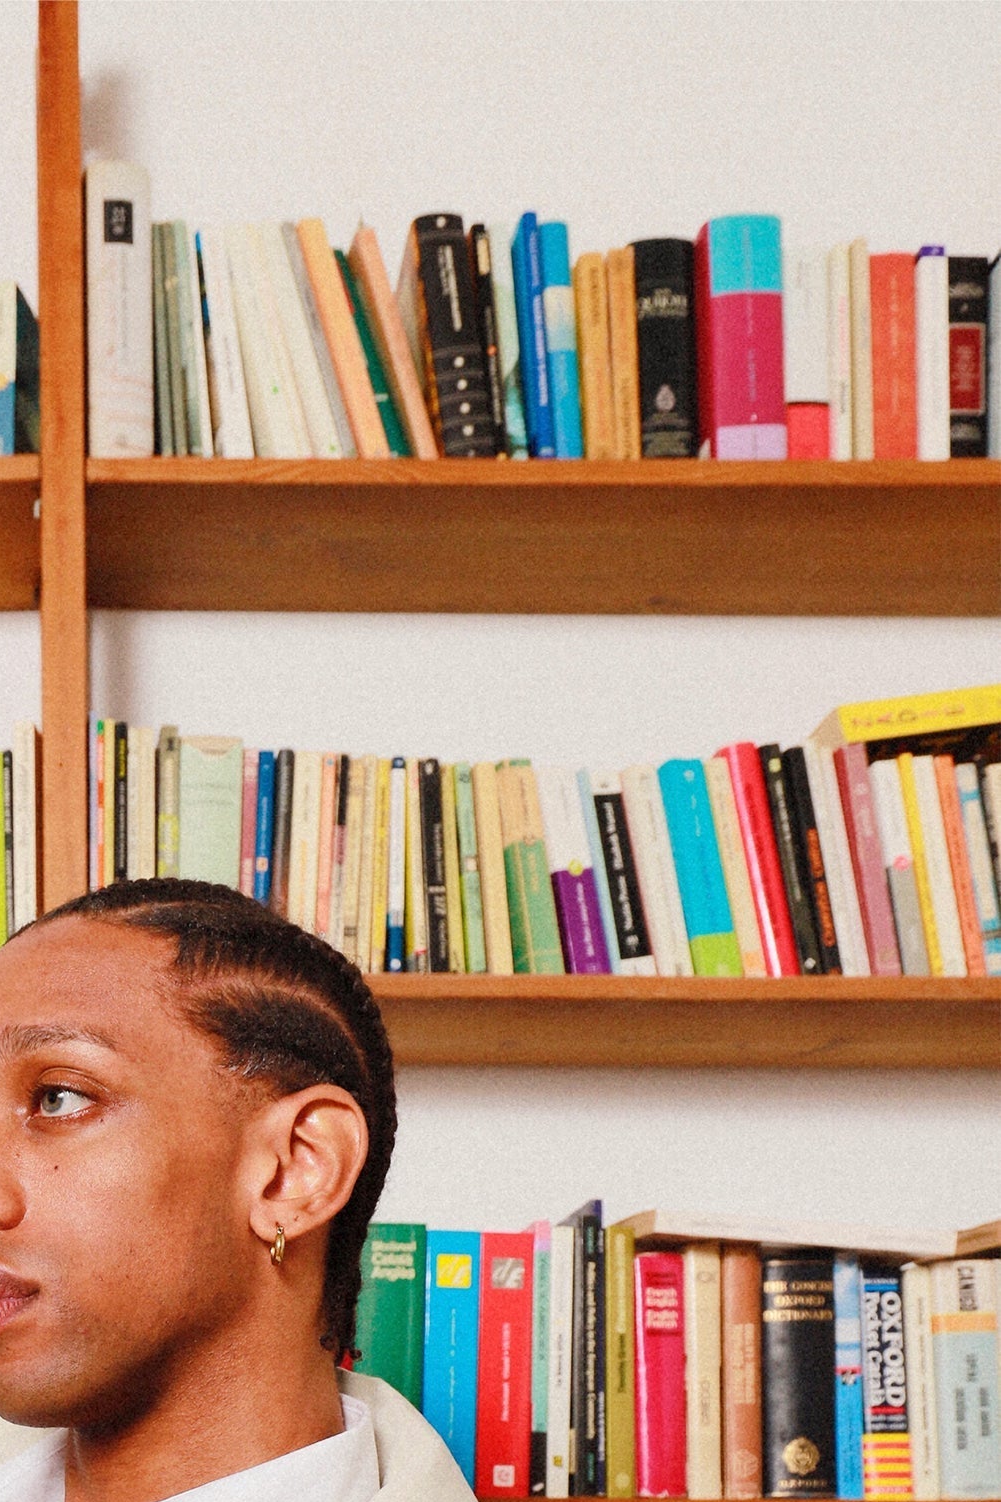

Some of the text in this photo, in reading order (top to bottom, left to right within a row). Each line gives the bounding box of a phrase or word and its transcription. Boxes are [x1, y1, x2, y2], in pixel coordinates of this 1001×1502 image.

[774, 1294, 826, 1307] OXFORD
[864, 1291, 881, 1349] Pocket
[881, 1291, 906, 1408] OXFORD
